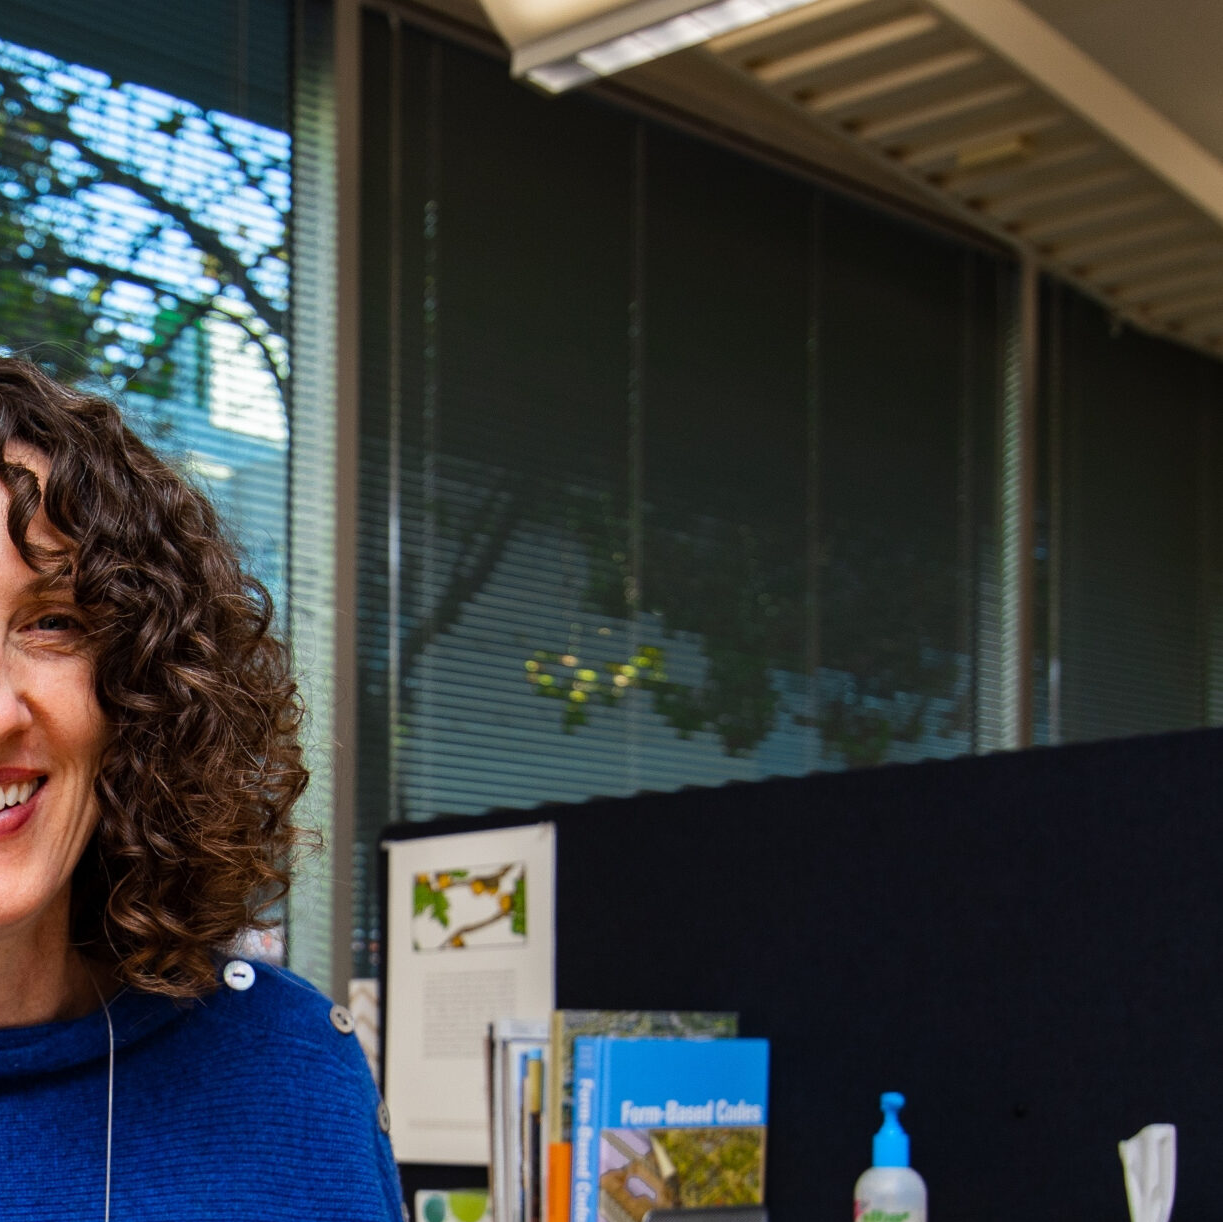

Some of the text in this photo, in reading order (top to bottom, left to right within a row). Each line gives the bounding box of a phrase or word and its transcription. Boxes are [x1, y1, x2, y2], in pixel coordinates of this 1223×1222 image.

[575, 1078, 595, 1179] Form-Based
[620, 1098, 762, 1125] Form-Based Codes
